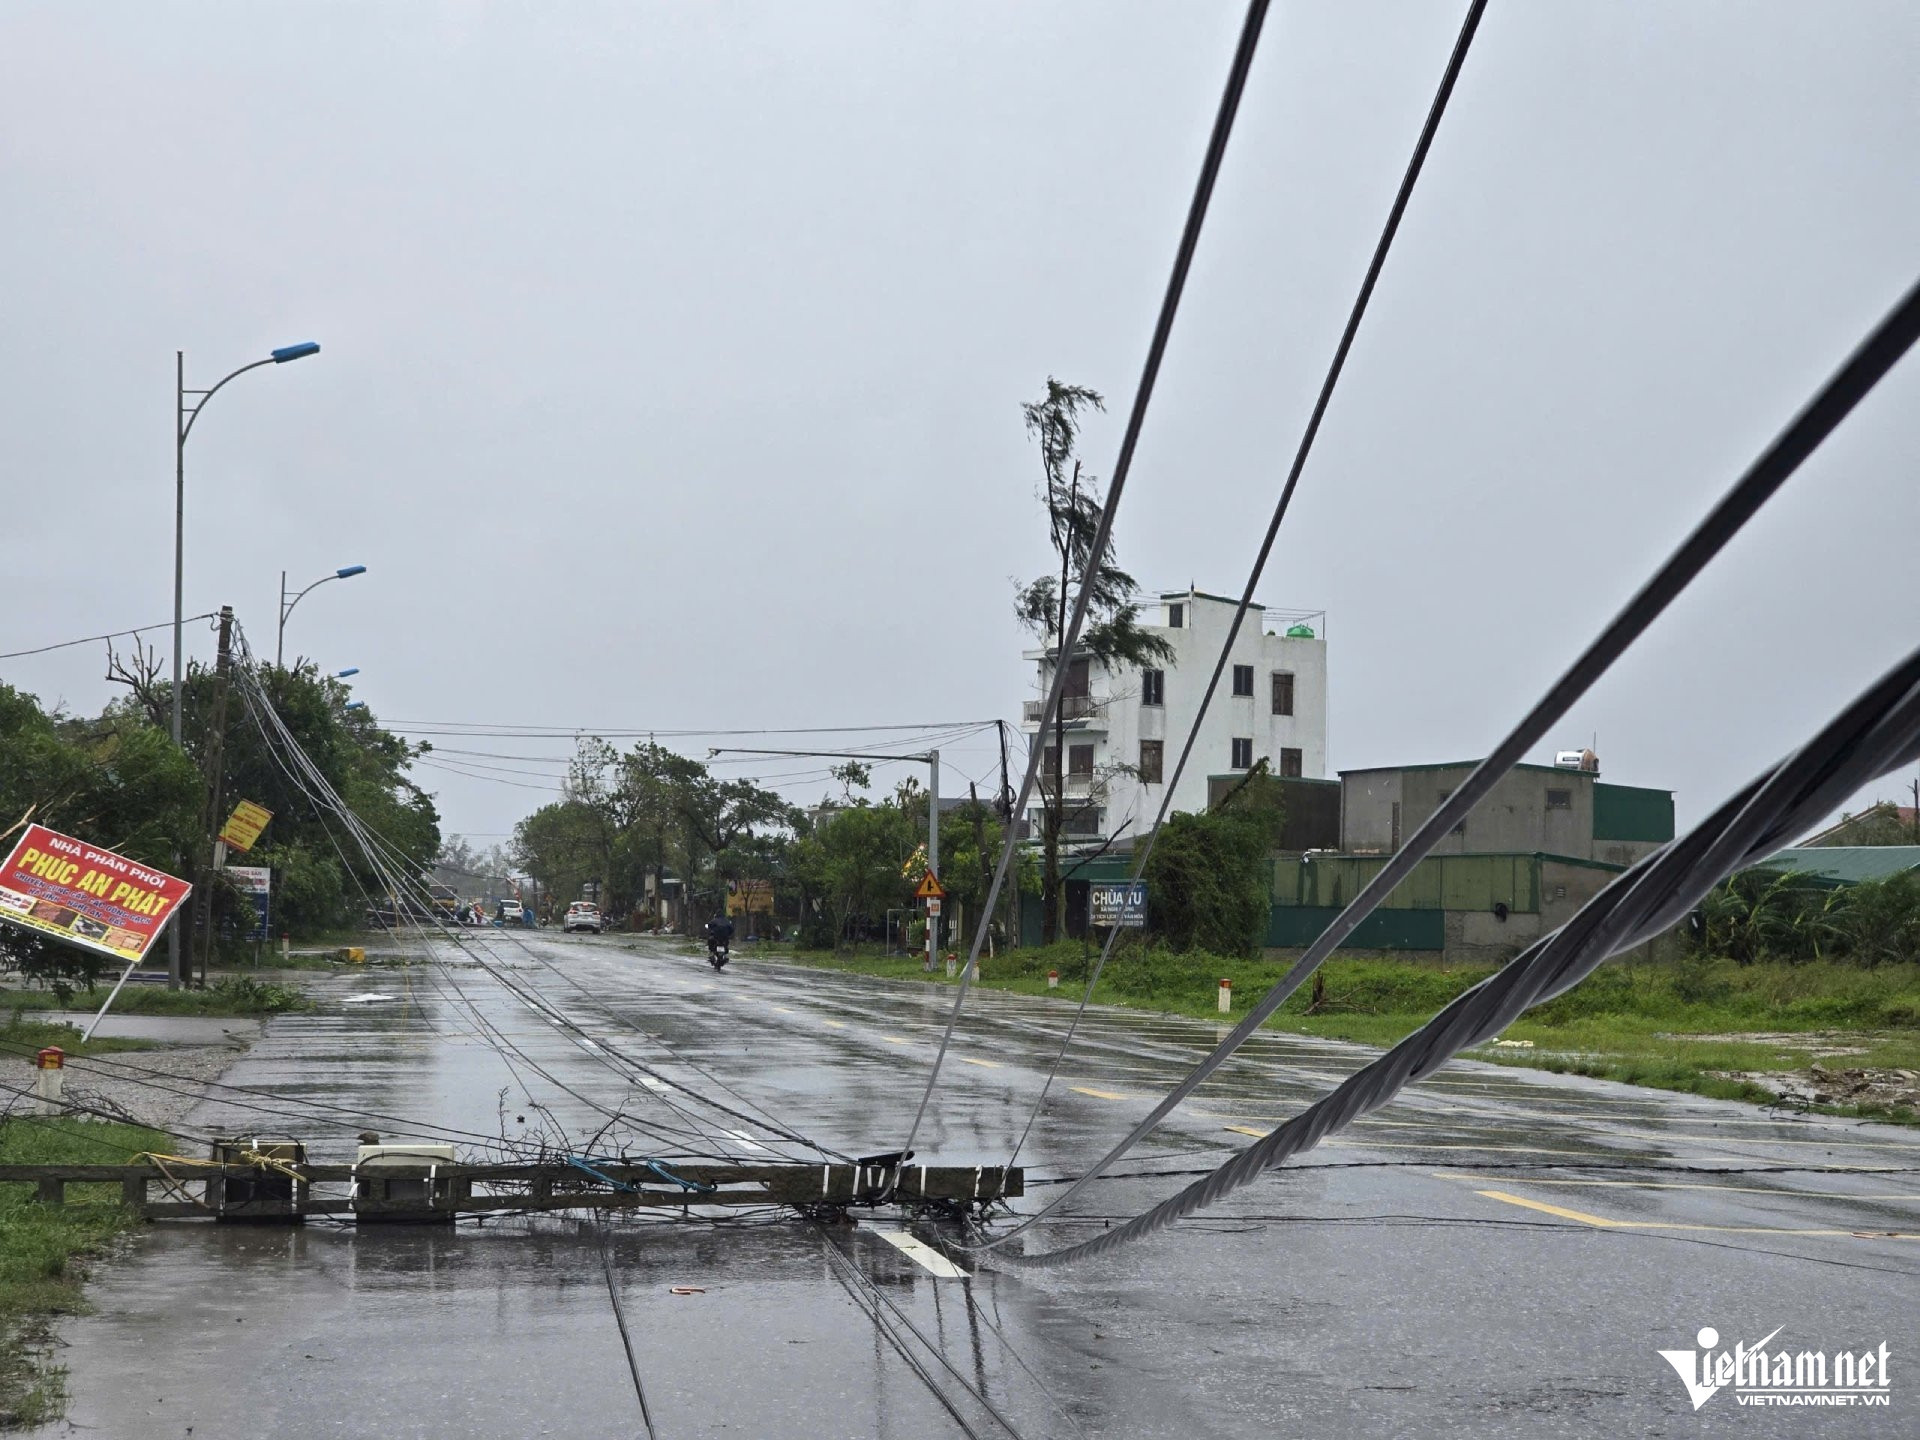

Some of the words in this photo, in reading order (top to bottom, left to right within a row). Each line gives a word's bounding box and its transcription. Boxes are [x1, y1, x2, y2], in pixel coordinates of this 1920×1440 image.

[18, 847, 79, 884] PHÚC
[75, 870, 113, 897] AN
[109, 881, 170, 916] PHÁT
[49, 837, 82, 857] NHÀ
[85, 851, 127, 873] PHÂN
[129, 868, 166, 888] PHỐI
[1092, 889, 1123, 905] CHÙA
